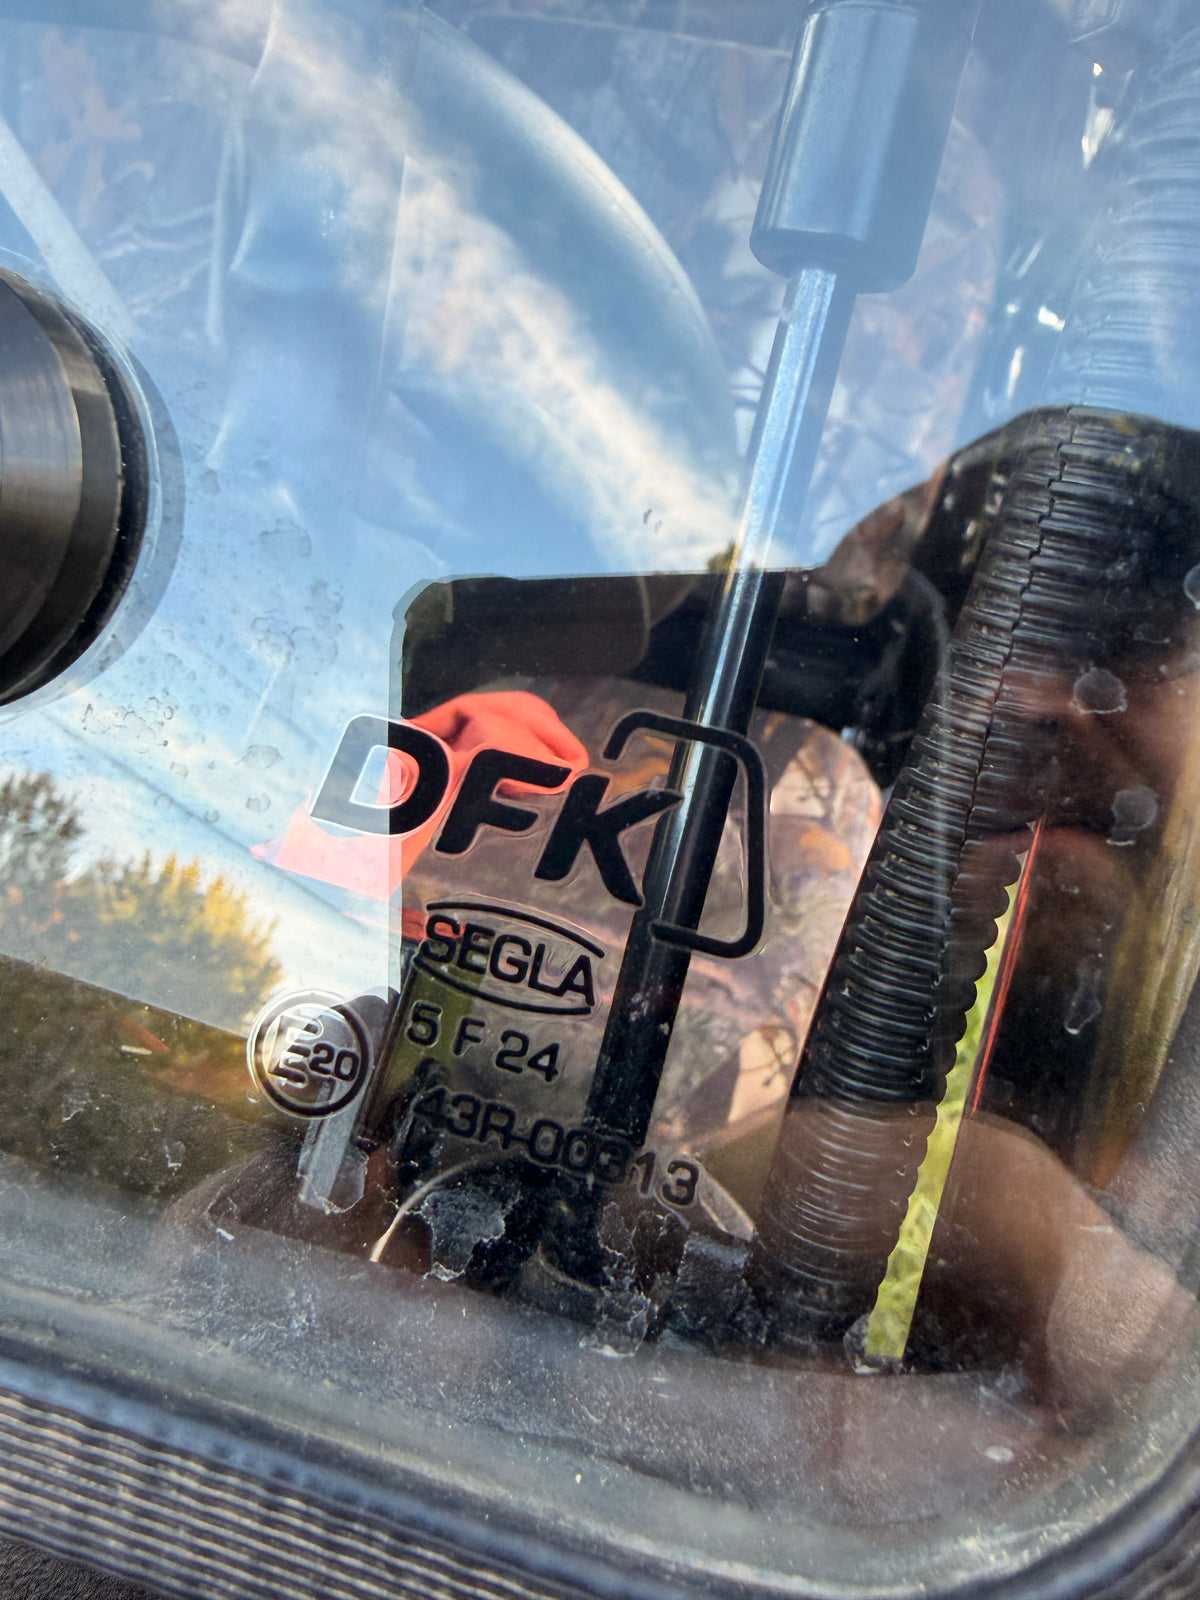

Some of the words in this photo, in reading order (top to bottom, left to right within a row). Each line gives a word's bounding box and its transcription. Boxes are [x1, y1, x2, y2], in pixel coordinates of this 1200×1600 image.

[309, 714, 683, 907] DFK
[419, 914, 595, 1006] SEGLA
[407, 1002, 442, 1046] 5
[453, 1017, 485, 1056] F
[496, 1029, 560, 1083] 24
